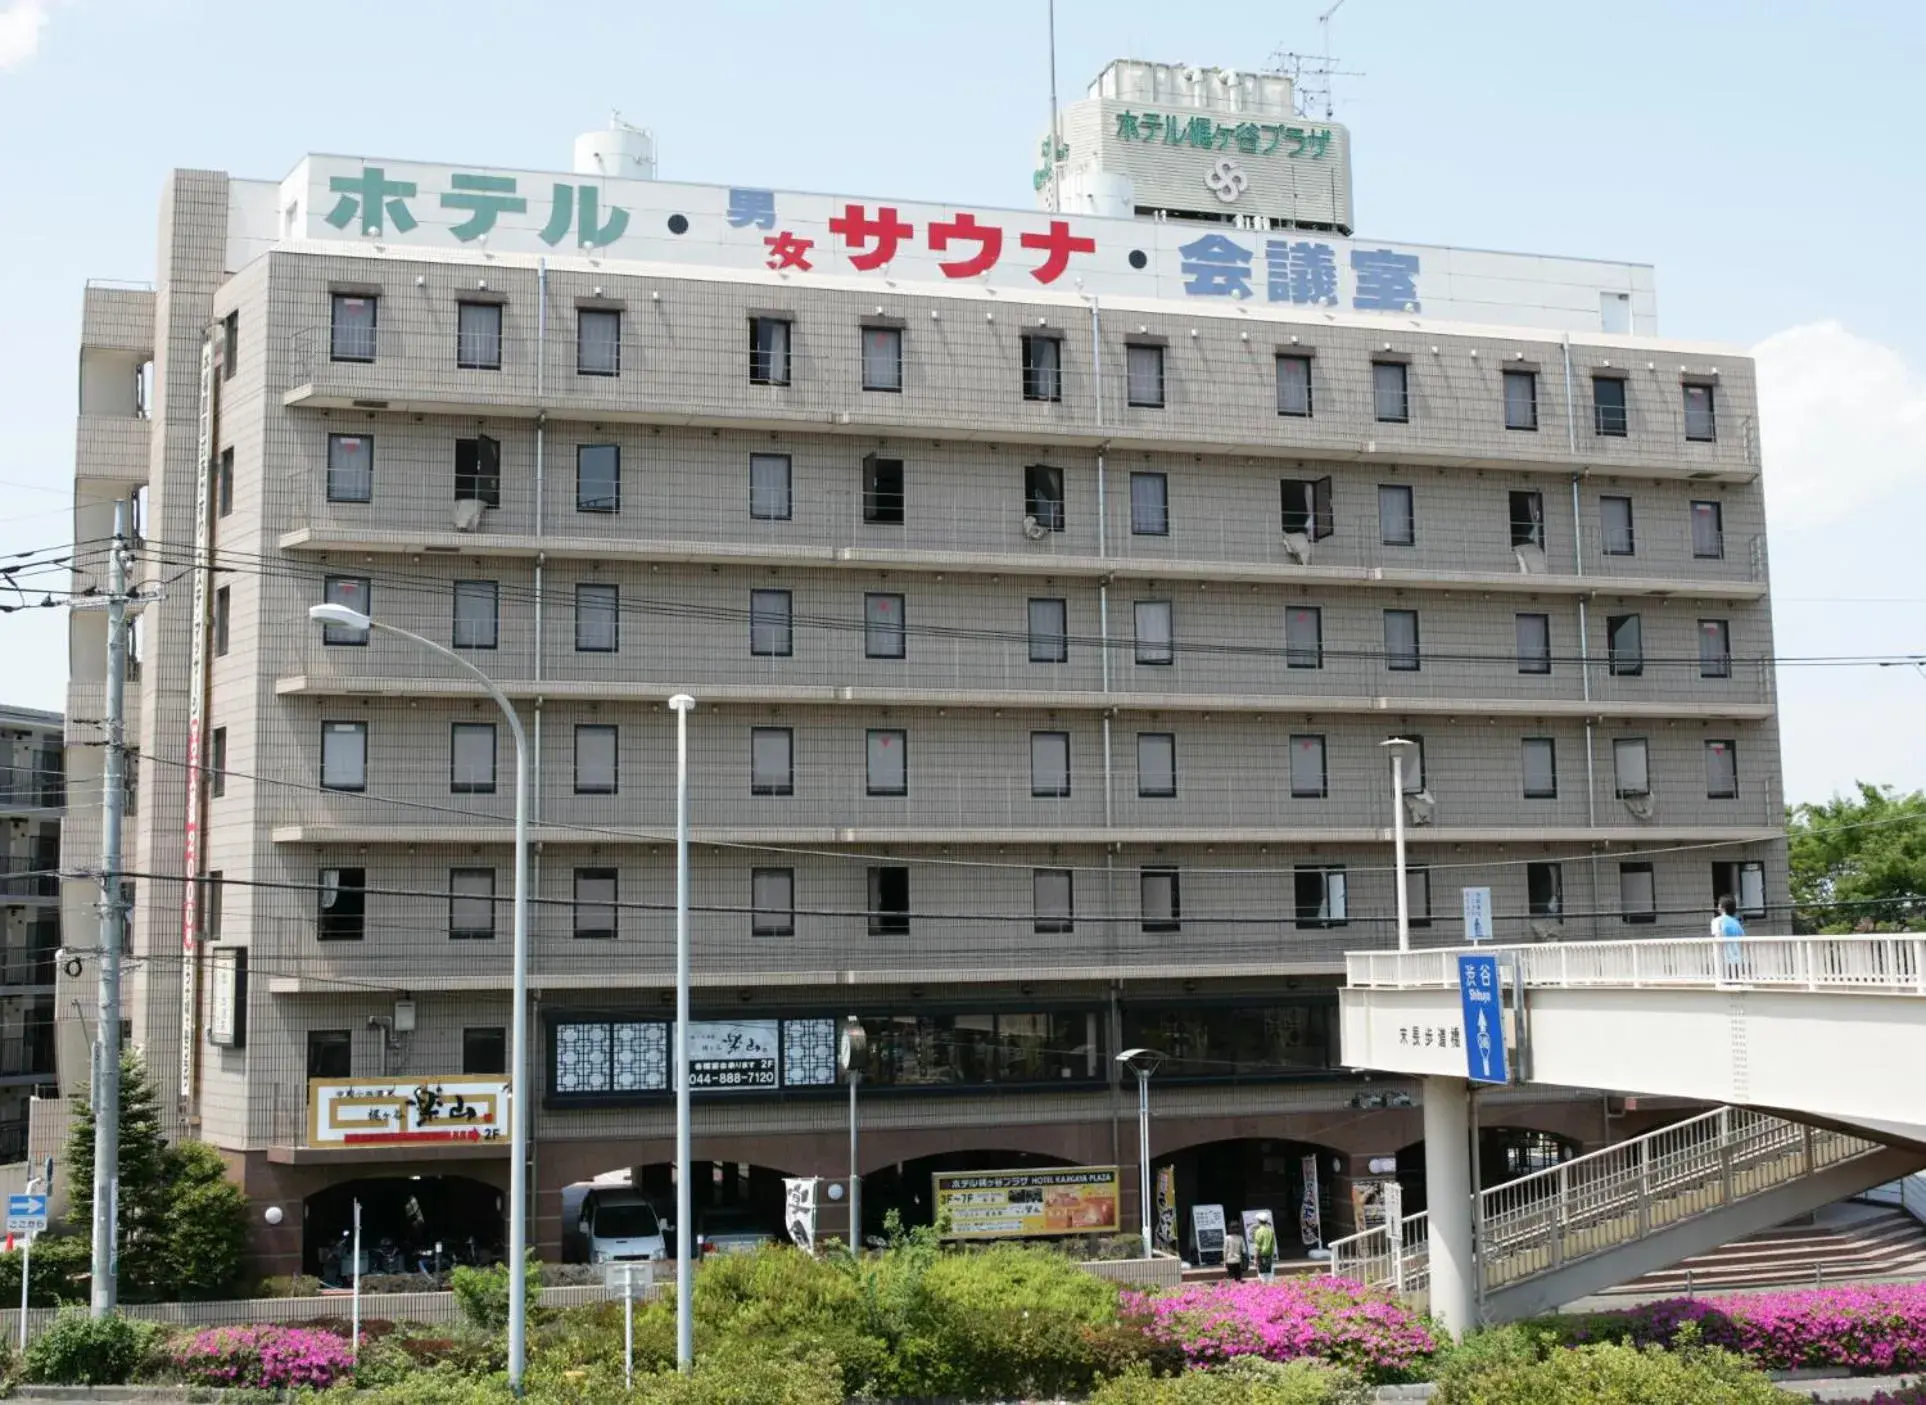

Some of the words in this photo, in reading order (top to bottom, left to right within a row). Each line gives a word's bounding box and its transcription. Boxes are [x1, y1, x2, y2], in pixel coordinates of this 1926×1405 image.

[324, 167, 630, 249] ホテル
[829, 204, 1096, 284] サウナ
[1178, 234, 1422, 313] 会議室
[1465, 964, 1491, 987] 渋谷
[761, 1060, 774, 1069] 2F
[689, 1072, 774, 1085] 044-888-7120
[484, 1127, 500, 1140] 2F
